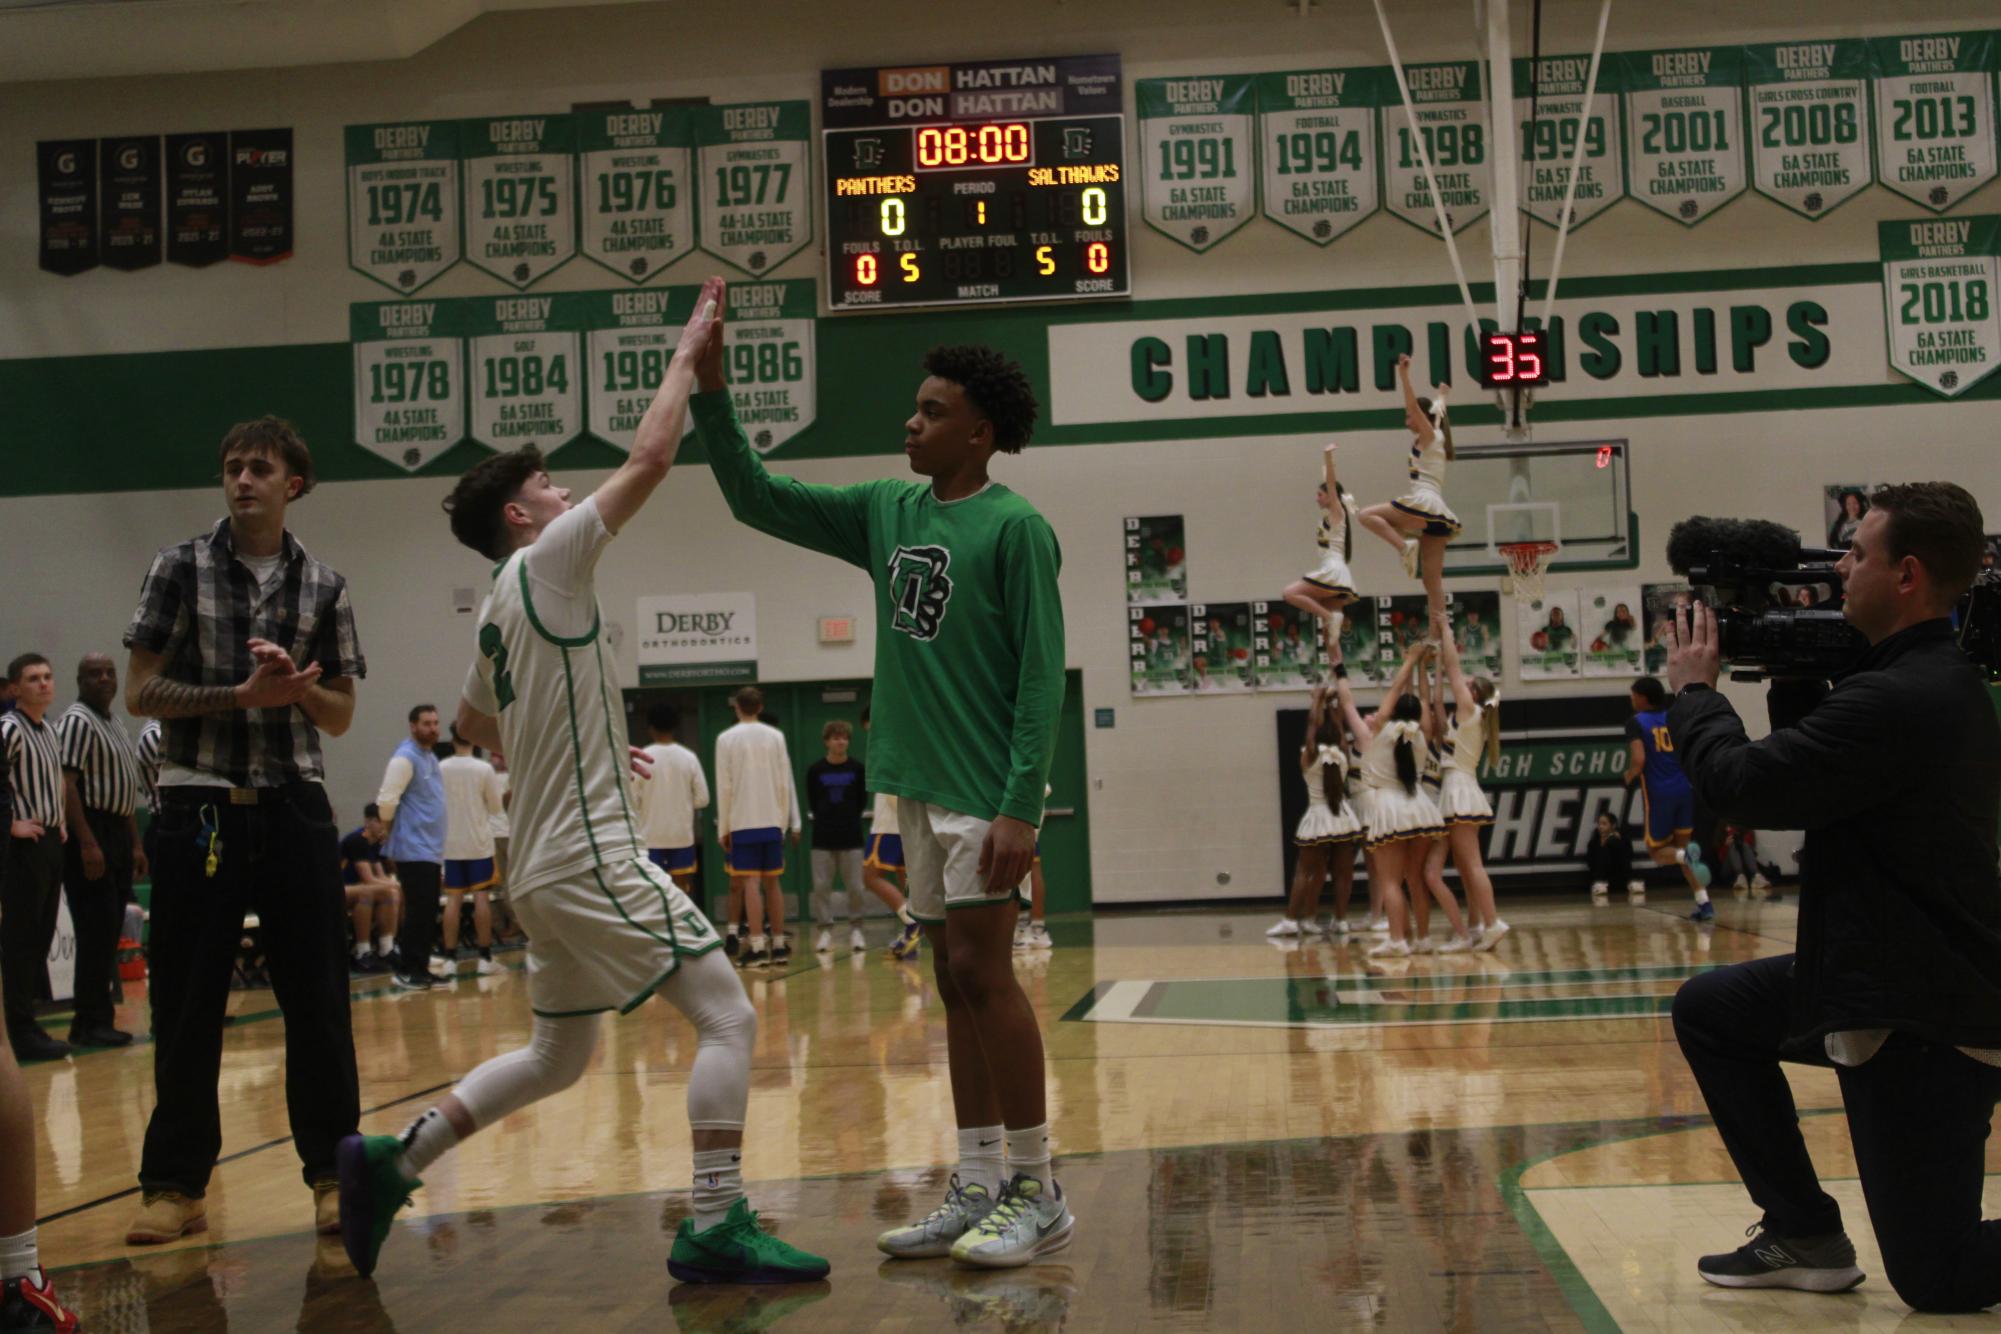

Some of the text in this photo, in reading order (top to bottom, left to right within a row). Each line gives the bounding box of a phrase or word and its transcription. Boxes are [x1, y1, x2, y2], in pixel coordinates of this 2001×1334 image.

[1776, 45, 1836, 68] DERBY
[1900, 37, 1960, 61] DERBY
[1653, 52, 1711, 76] DERBY
[1909, 60, 1954, 73] PANTHERS
[888, 66, 1056, 91] DON HATTAN
[1408, 66, 1467, 89] DERBY
[1661, 75, 1705, 87] PANTHERS
[1784, 68, 1830, 80] PANTHERS
[1166, 80, 1224, 102] DERBY
[1287, 73, 1345, 96] DERBY
[1910, 82, 1955, 93] FOOTBALL
[1295, 96, 1339, 107] PANTHERS
[1662, 96, 1705, 108] BASEBALL
[1759, 87, 1857, 102] GIRLS CROSS COUNTRY
[888, 92, 1056, 118] DON HATTAN
[607, 113, 663, 136] DERBY
[723, 107, 780, 129] DERBY
[1296, 116, 1340, 128] FOOTBALL
[1762, 103, 1857, 148] 2008
[1894, 96, 1976, 141] 2013
[374, 126, 430, 149] DERBY
[489, 120, 545, 143] DERBY
[1170, 123, 1223, 135] GYMNASTICS
[1642, 110, 1728, 154] 2001
[919, 125, 1028, 166] 08:00
[1399, 124, 1483, 168] 1998
[1521, 117, 1605, 161] 1999
[1160, 138, 1236, 180] 1991
[1277, 131, 1362, 174] 1994
[1782, 153, 1839, 170] 6A STATE
[1907, 146, 1965, 164] 6A STATE
[1028, 164, 1119, 186] SALTHAWKS
[1536, 167, 1592, 183] 6A STTE
[1658, 160, 1715, 177] 6A STATE
[1899, 163, 1976, 182] CHAMPIONS
[716, 164, 792, 207] 1977
[837, 175, 916, 196] PANTHERS
[1293, 180, 1348, 196] 6A STATE
[1435, 174, 1470, 188] STATE
[1650, 177, 1725, 195] CHAMPIONS
[1774, 170, 1850, 188] CHAMPIONS
[482, 177, 557, 218] 1975
[598, 170, 675, 213] 1976
[954, 183, 995, 194] PERIOD
[1171, 187, 1226, 203] 6A STATE
[1528, 183, 1603, 201] CHAMONS
[368, 182, 442, 225] 1974
[977, 201, 985, 224] 1
[1082, 188, 1106, 225] 0
[1162, 203, 1236, 221] CHAMPIONS
[1285, 196, 1358, 214] CHAMPIONS
[758, 212, 792, 227] STATE
[881, 199, 905, 235] 0
[493, 225, 547, 240] 4A STATE
[611, 218, 664, 235] 4A STATE
[1075, 230, 1112, 241] FOULS
[1910, 221, 1970, 246] DERBY
[379, 231, 432, 246] 4A STATE
[603, 235, 674, 252] CHAMPIONS
[721, 229, 793, 246] CHAMPIONS
[940, 235, 1017, 248] PLAYER FOUL
[371, 247, 442, 264] CHAMPIONS
[486, 241, 556, 258] CHAMPIONS
[843, 242, 880, 253] FOULS
[1088, 243, 1108, 272] 0
[857, 255, 877, 284] 0
[1901, 264, 1985, 279] GIRLS BASKETBALL
[958, 286, 998, 297] MATCH
[1076, 280, 1113, 292] SCORE
[612, 291, 669, 315] DERBY
[729, 285, 786, 308] DERBY
[845, 291, 881, 302] SCORE
[1901, 281, 1988, 325] 2018
[379, 304, 436, 327] DERBY
[496, 298, 552, 320] DERBY
[514, 341, 535, 352] GOLF
[1918, 331, 1975, 347] 6A STATE
[1490, 335, 1540, 380] 35
[1909, 347, 1986, 365] CHAMPIONS
[371, 360, 449, 403] 1978
[485, 355, 568, 398] 1984
[617, 400, 633, 414] 6A
[754, 391, 789, 406] STATE
[384, 409, 437, 423] 4A STATE
[500, 403, 554, 420] 6A STATE
[736, 407, 798, 423] HAMPIONS
[376, 425, 446, 442] CHAMPIONS
[492, 419, 563, 437] CHAMPIONS
[656, 612, 735, 635] DERBY
[642, 637, 750, 649] ORTHODONTICS
[1652, 727, 1674, 752] 10
[1482, 754, 1533, 778] IGH
